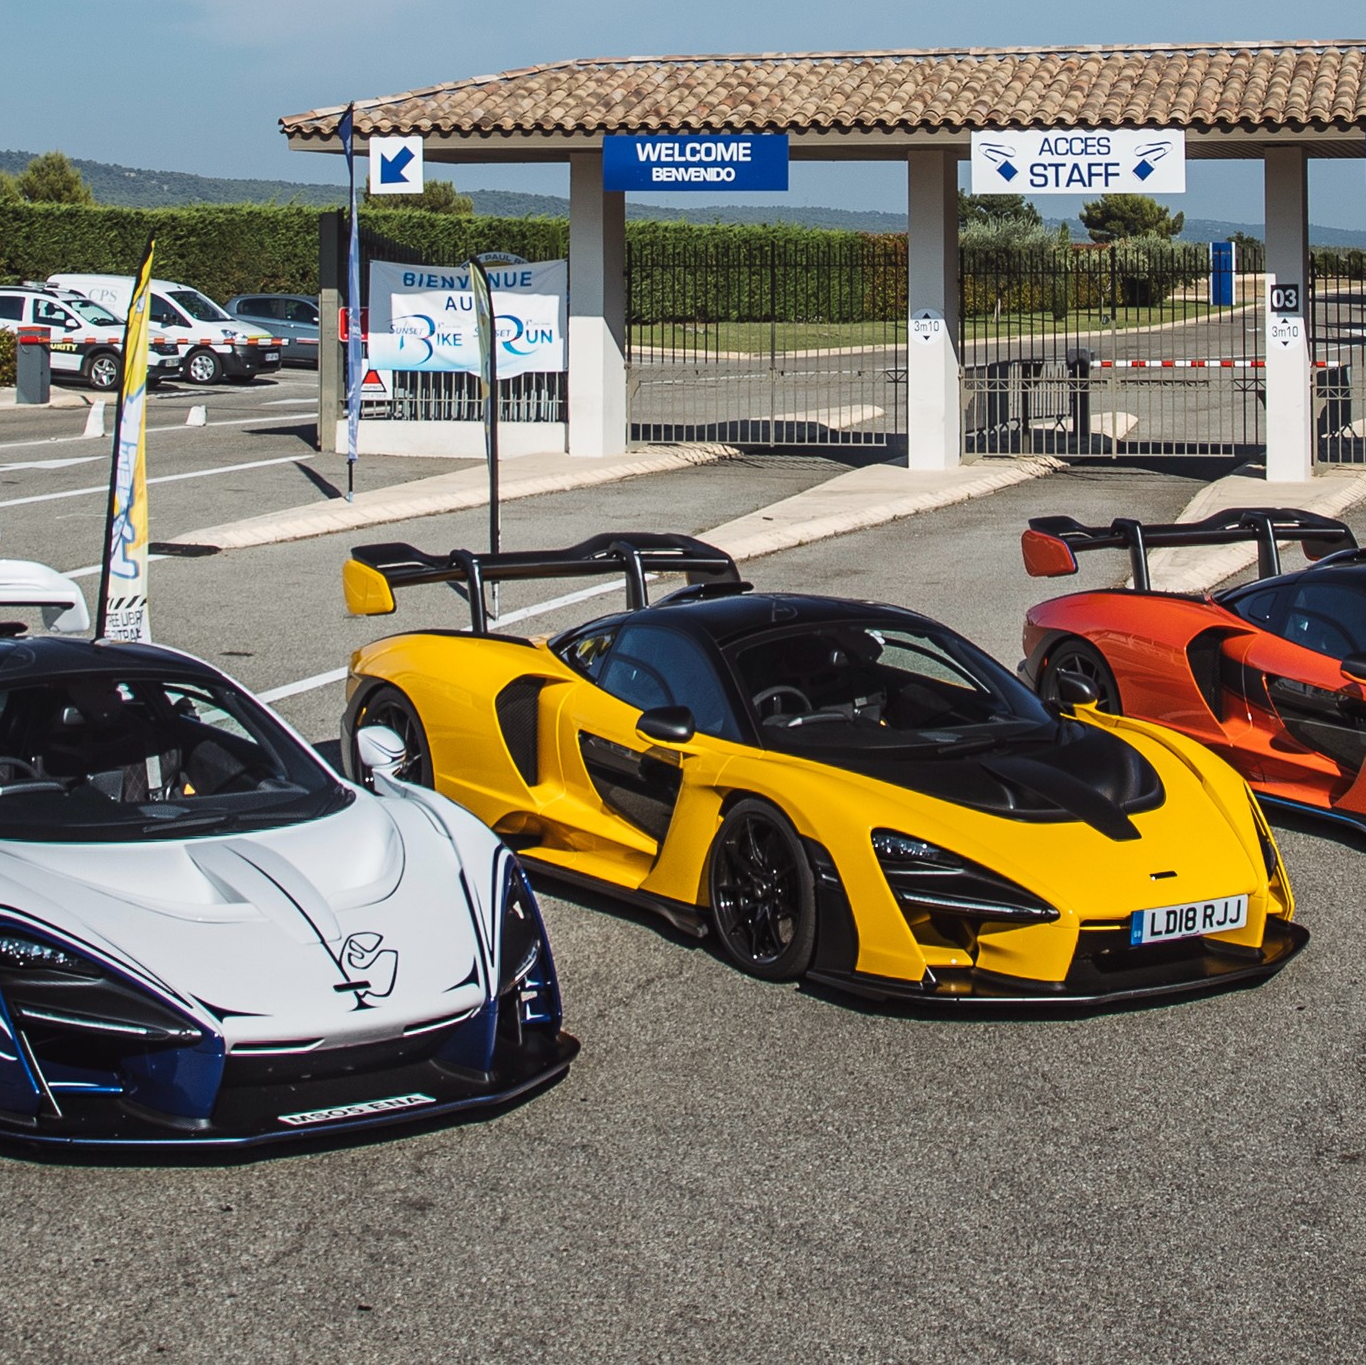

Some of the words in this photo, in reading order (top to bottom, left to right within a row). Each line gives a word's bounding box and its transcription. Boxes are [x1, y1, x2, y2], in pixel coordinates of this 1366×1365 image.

[636, 142, 752, 162] WELCOME
[1038, 137, 1111, 156] ACCES
[651, 167, 736, 182] BENVENIDO
[1029, 162, 1120, 188] STAFF
[403, 271, 532, 289] BIENVNUE
[88, 288, 118, 303] CPS
[445, 296, 472, 311] AU
[1271, 289, 1297, 308] 03
[914, 321, 939, 332] 3m10
[1272, 326, 1298, 337] 3m10
[1150, 906, 1197, 937] LD18
[1202, 899, 1242, 929] RJJ
